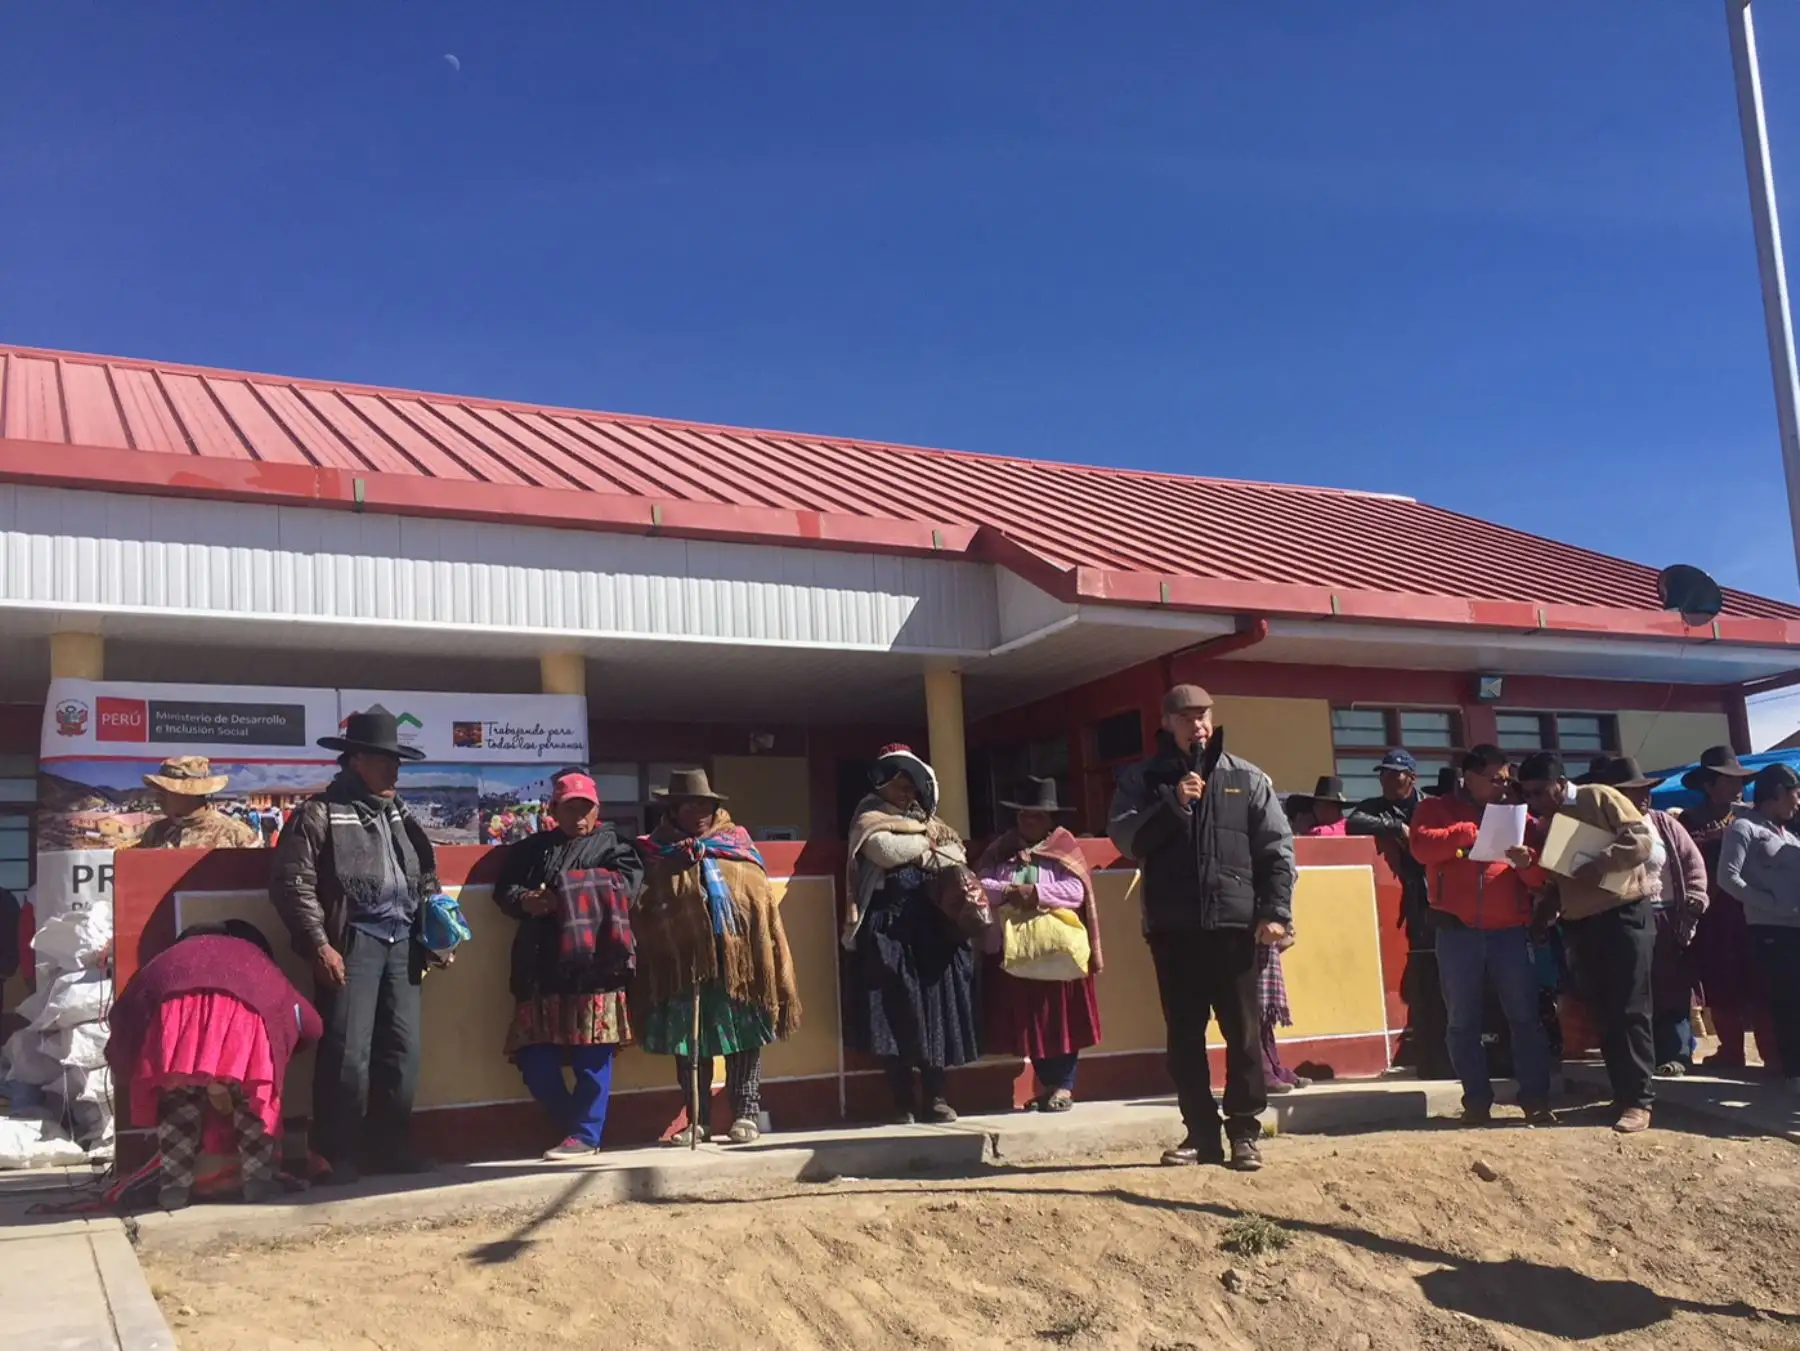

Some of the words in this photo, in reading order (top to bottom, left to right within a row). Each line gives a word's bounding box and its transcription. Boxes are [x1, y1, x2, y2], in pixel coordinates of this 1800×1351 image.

[101, 710, 141, 726] PERÚ
[156, 710, 212, 723] Ministerio
[214, 713, 228, 724] de
[231, 713, 287, 726] Desarrollo
[155, 726, 162, 734] e
[166, 724, 214, 735] Inclusión
[217, 726, 249, 737] Social
[483, 720, 545, 739] Trabajando
[547, 728, 574, 742] para
[536, 739, 584, 758] peruanos
